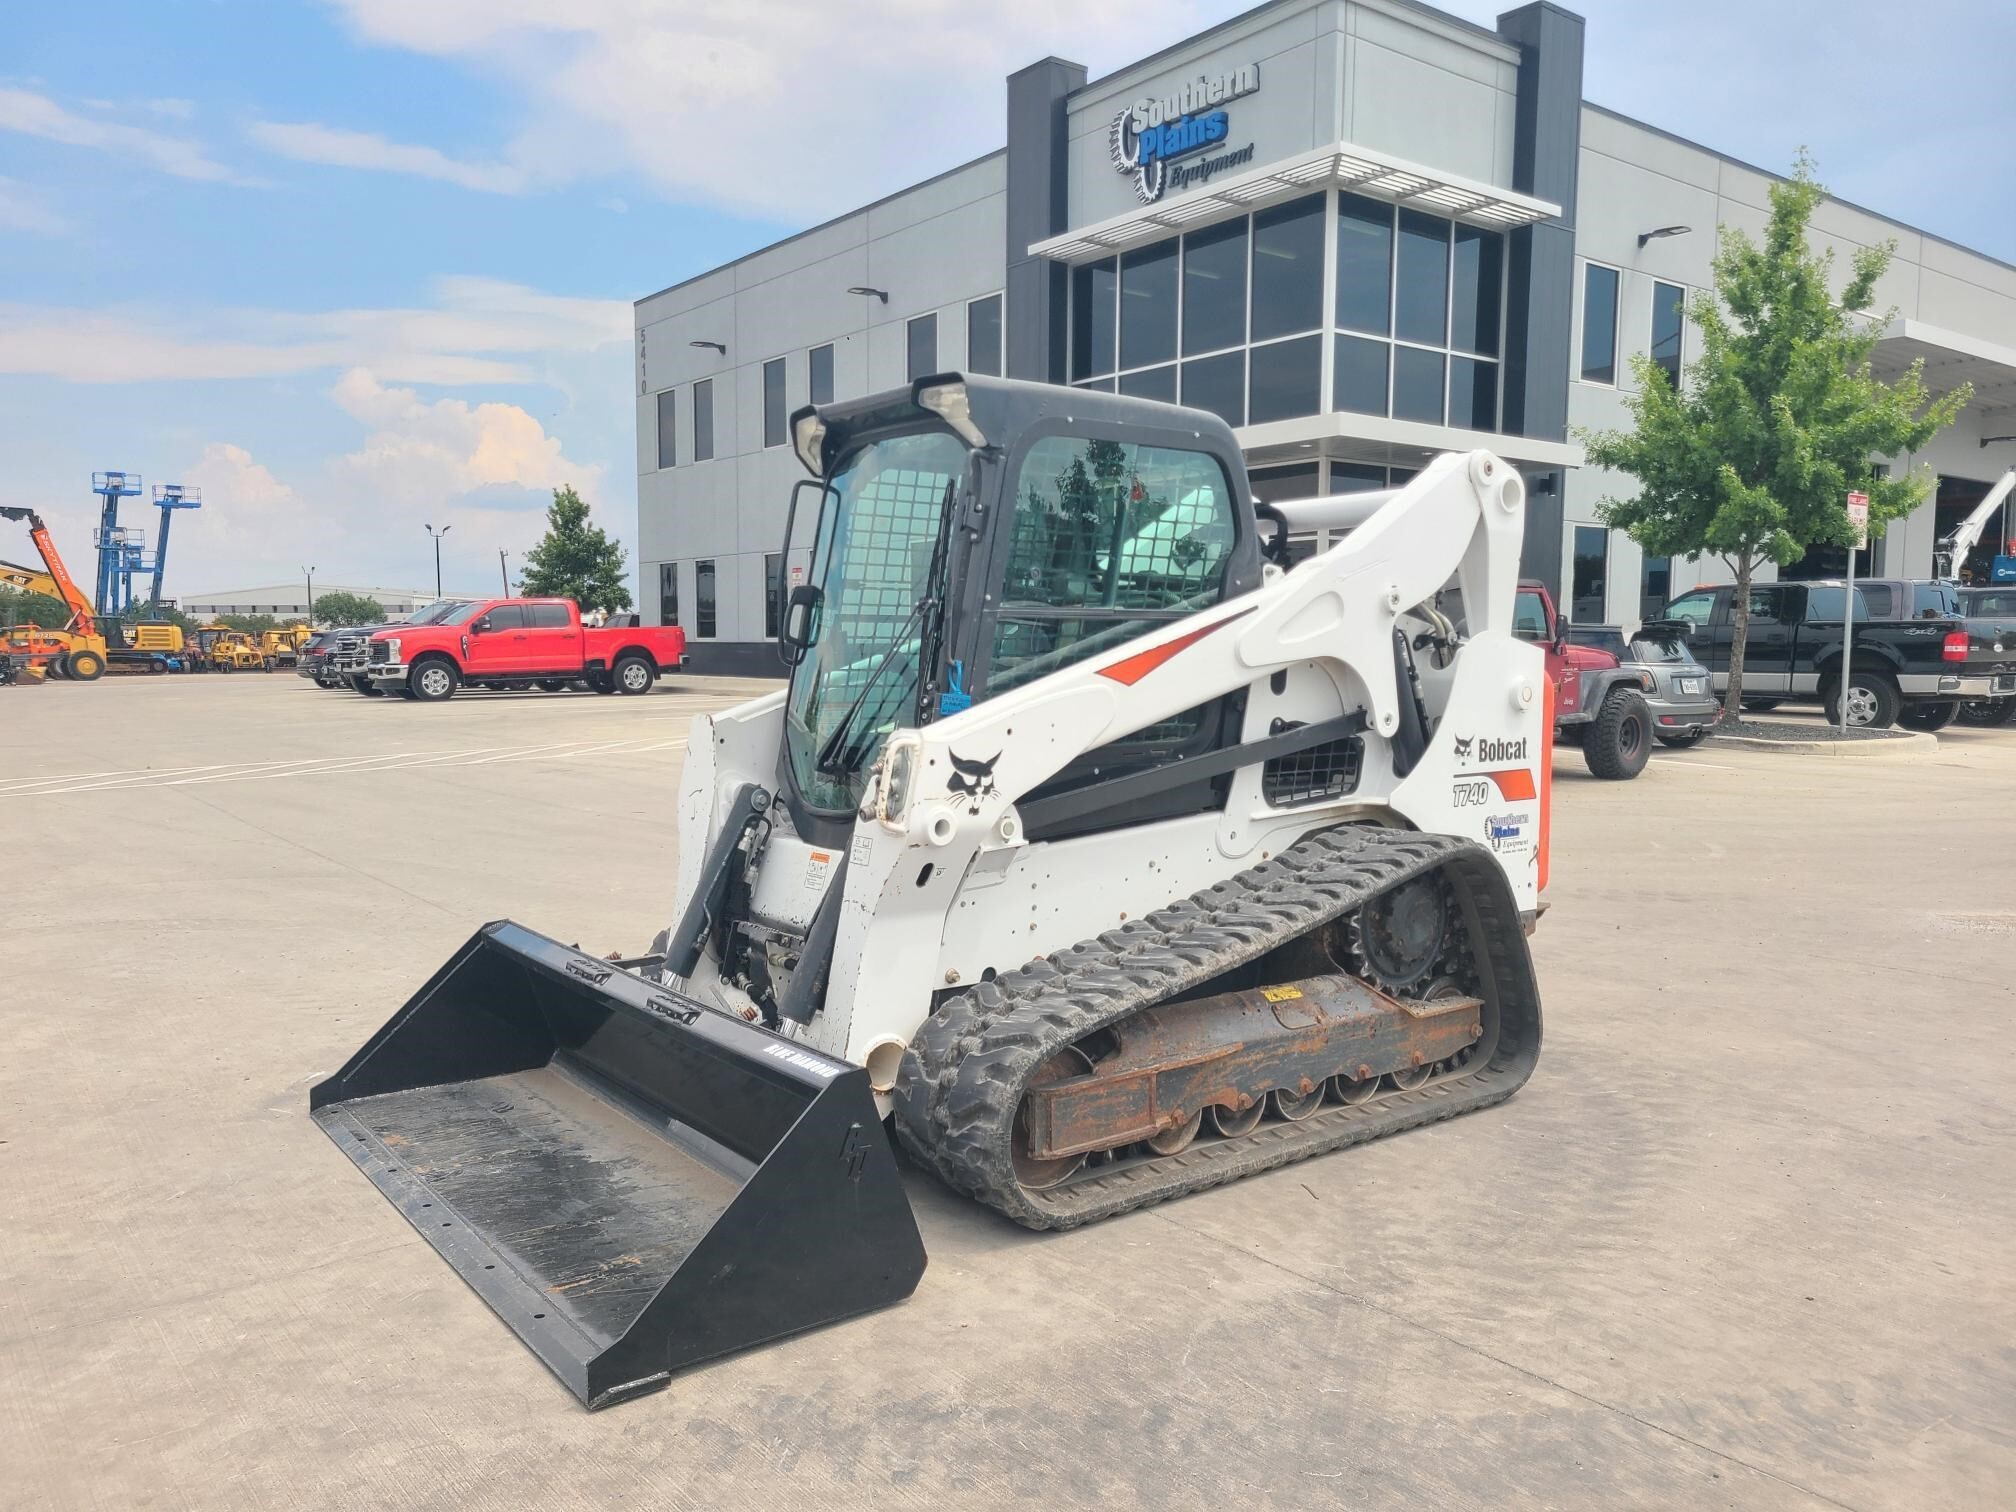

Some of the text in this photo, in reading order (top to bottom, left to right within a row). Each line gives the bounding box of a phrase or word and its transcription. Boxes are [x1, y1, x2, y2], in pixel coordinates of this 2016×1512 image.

[1132, 64, 1260, 134] Southern
[1138, 111, 1229, 166] Plains
[1167, 142, 1255, 189] Equipment
[44, 538, 66, 582] SKYTRAK
[13, 575, 28, 585] CAT
[123, 629, 136, 638] CAT
[1478, 737, 1527, 763] Bobcat
[1453, 782, 1489, 807] T740
[1491, 813, 1529, 826] Southern
[1502, 839, 1529, 849] Equipment
[762, 1044, 840, 1078] BLUE DIAMOND
